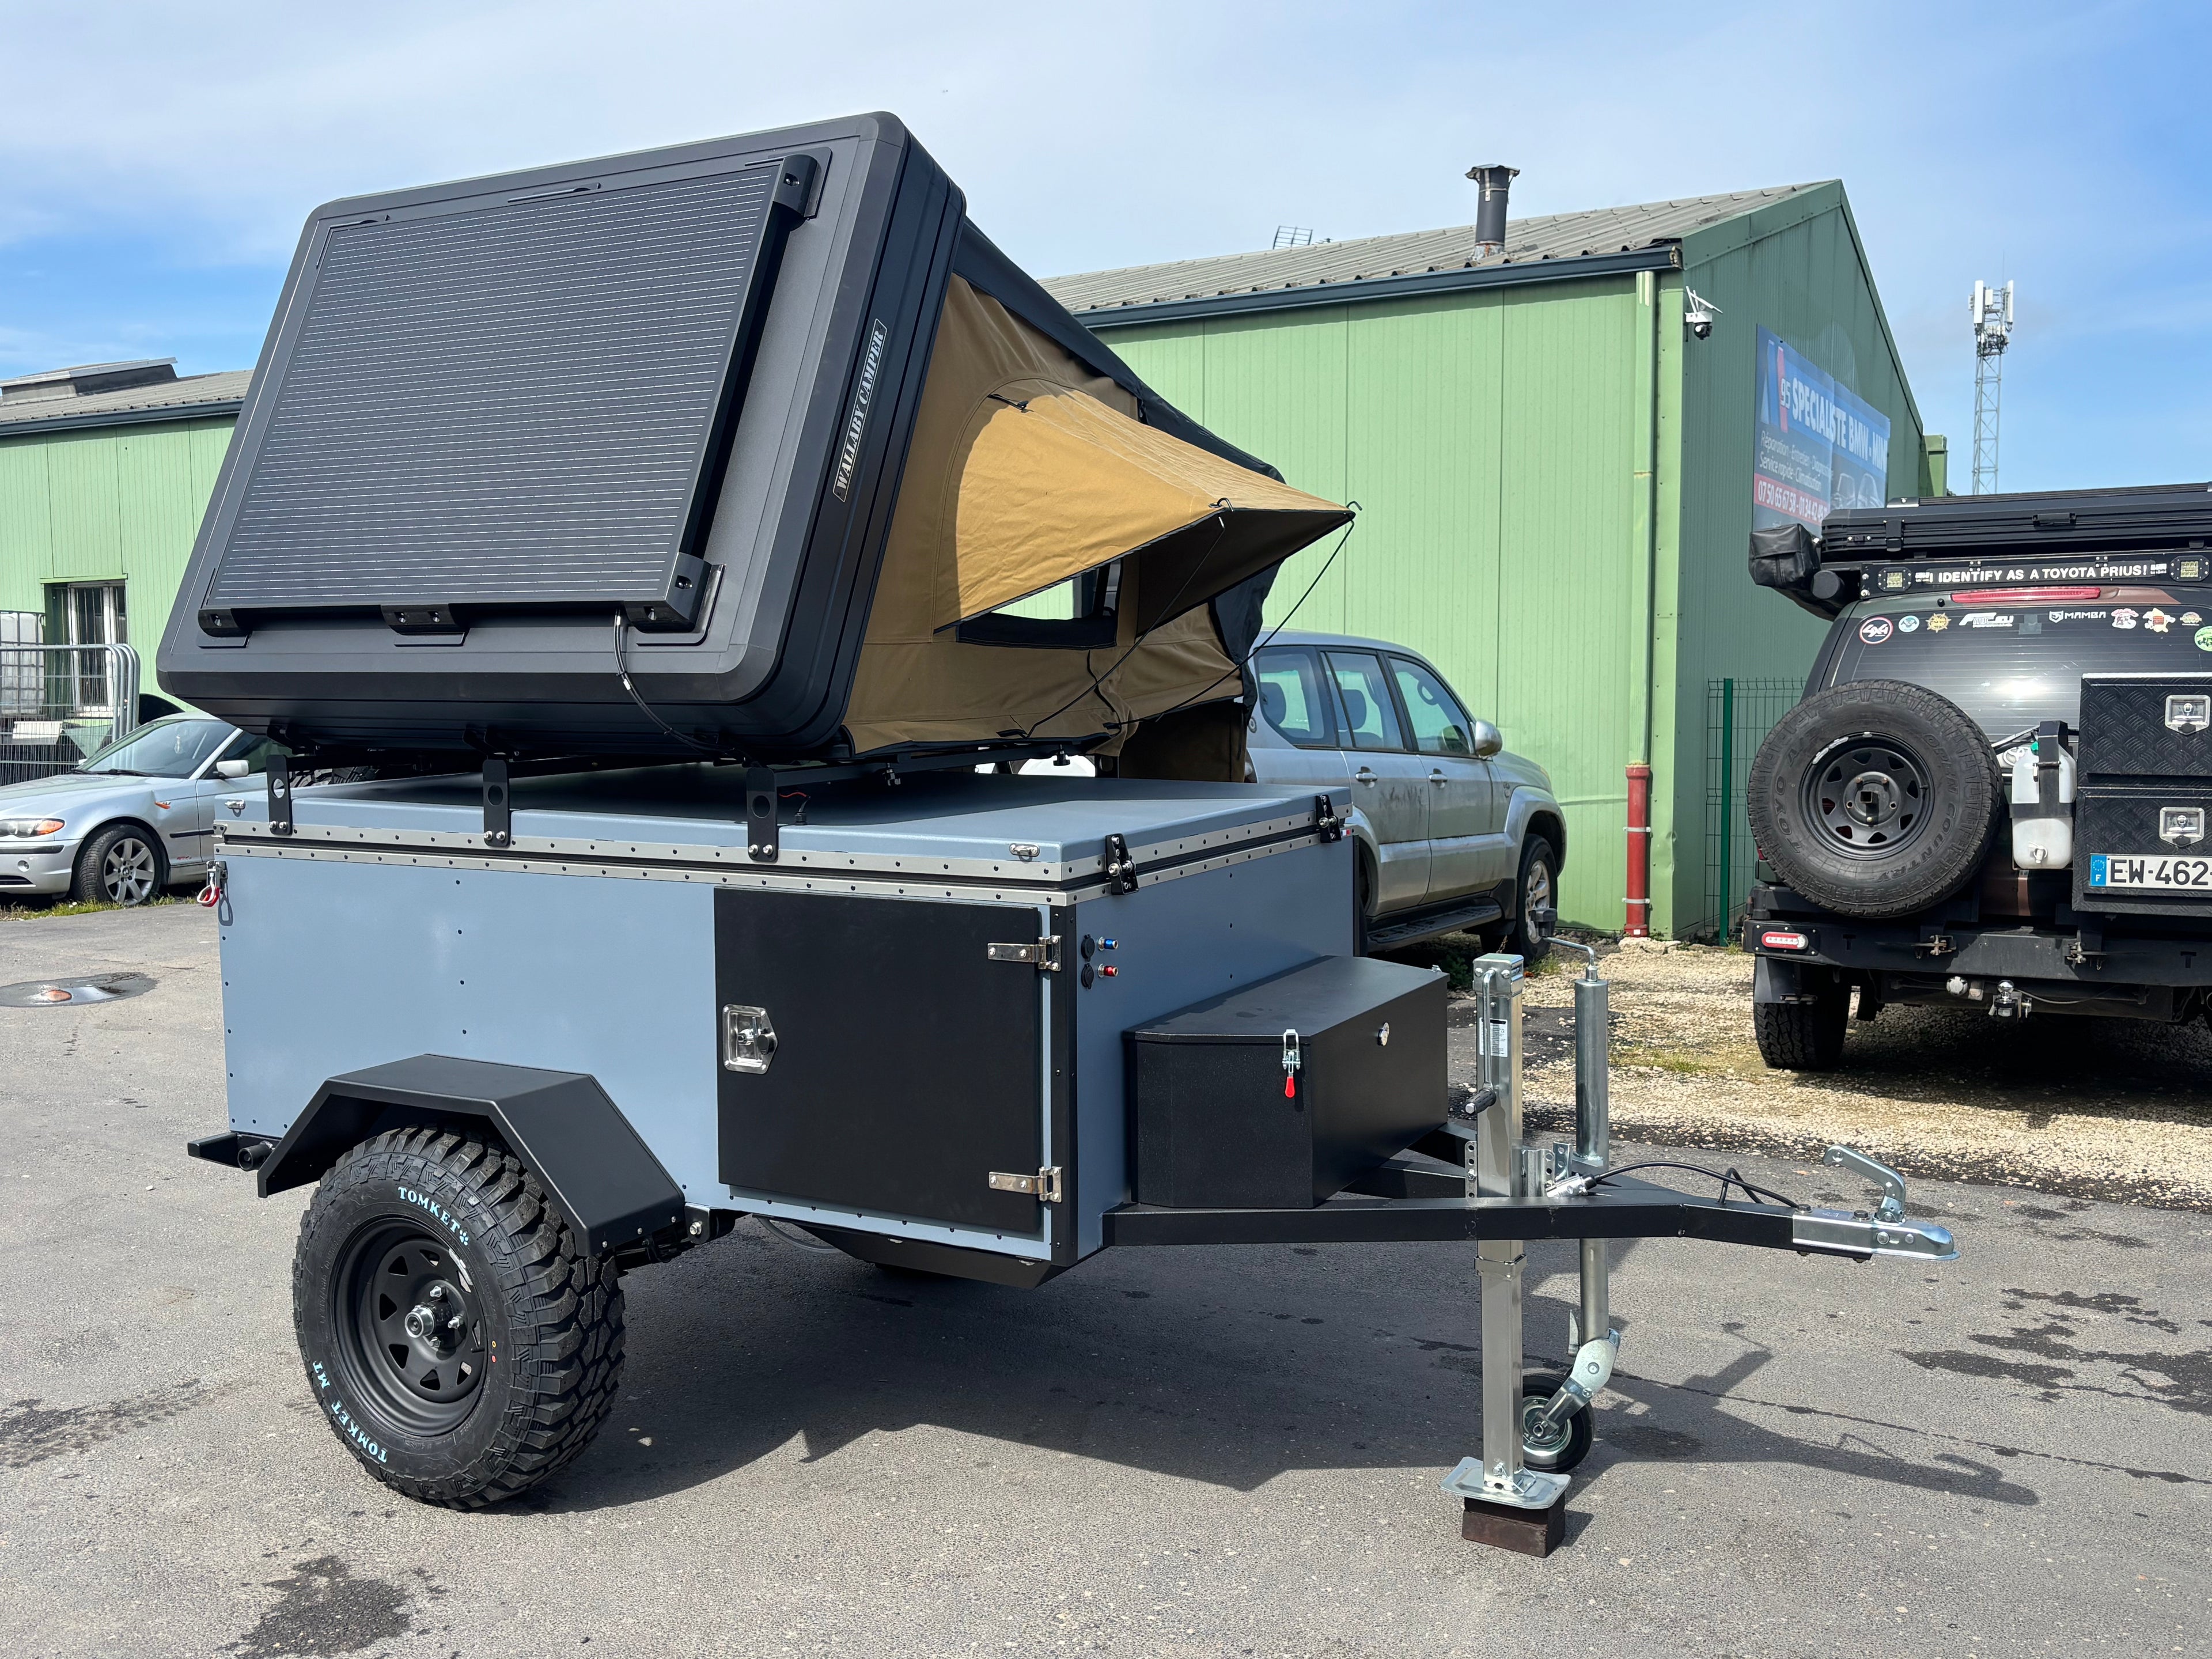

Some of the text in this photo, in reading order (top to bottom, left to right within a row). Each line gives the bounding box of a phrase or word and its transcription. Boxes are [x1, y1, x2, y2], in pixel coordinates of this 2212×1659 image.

[836, 330, 884, 489] WALLABY CAMPER
[1792, 377, 1846, 449] SPECIALISTE
[1849, 415, 1869, 461] BMW
[1759, 452, 1778, 472] Service
[1758, 480, 1766, 502] 07
[1938, 570, 2002, 582] IDENTIFY
[2006, 569, 2024, 580] AS
[2030, 569, 2039, 579] A
[2042, 566, 2096, 579] TOYOTA
[2100, 565, 2147, 577] PRIUS!
[2065, 611, 2107, 619] MAMBA
[1775, 776, 1802, 854] TOYO
[1876, 802, 1956, 882] COUNTRY
[398, 1187, 460, 1233] TOMKET
[313, 1361, 330, 1389] MT
[331, 1401, 388, 1463] TOMKET
